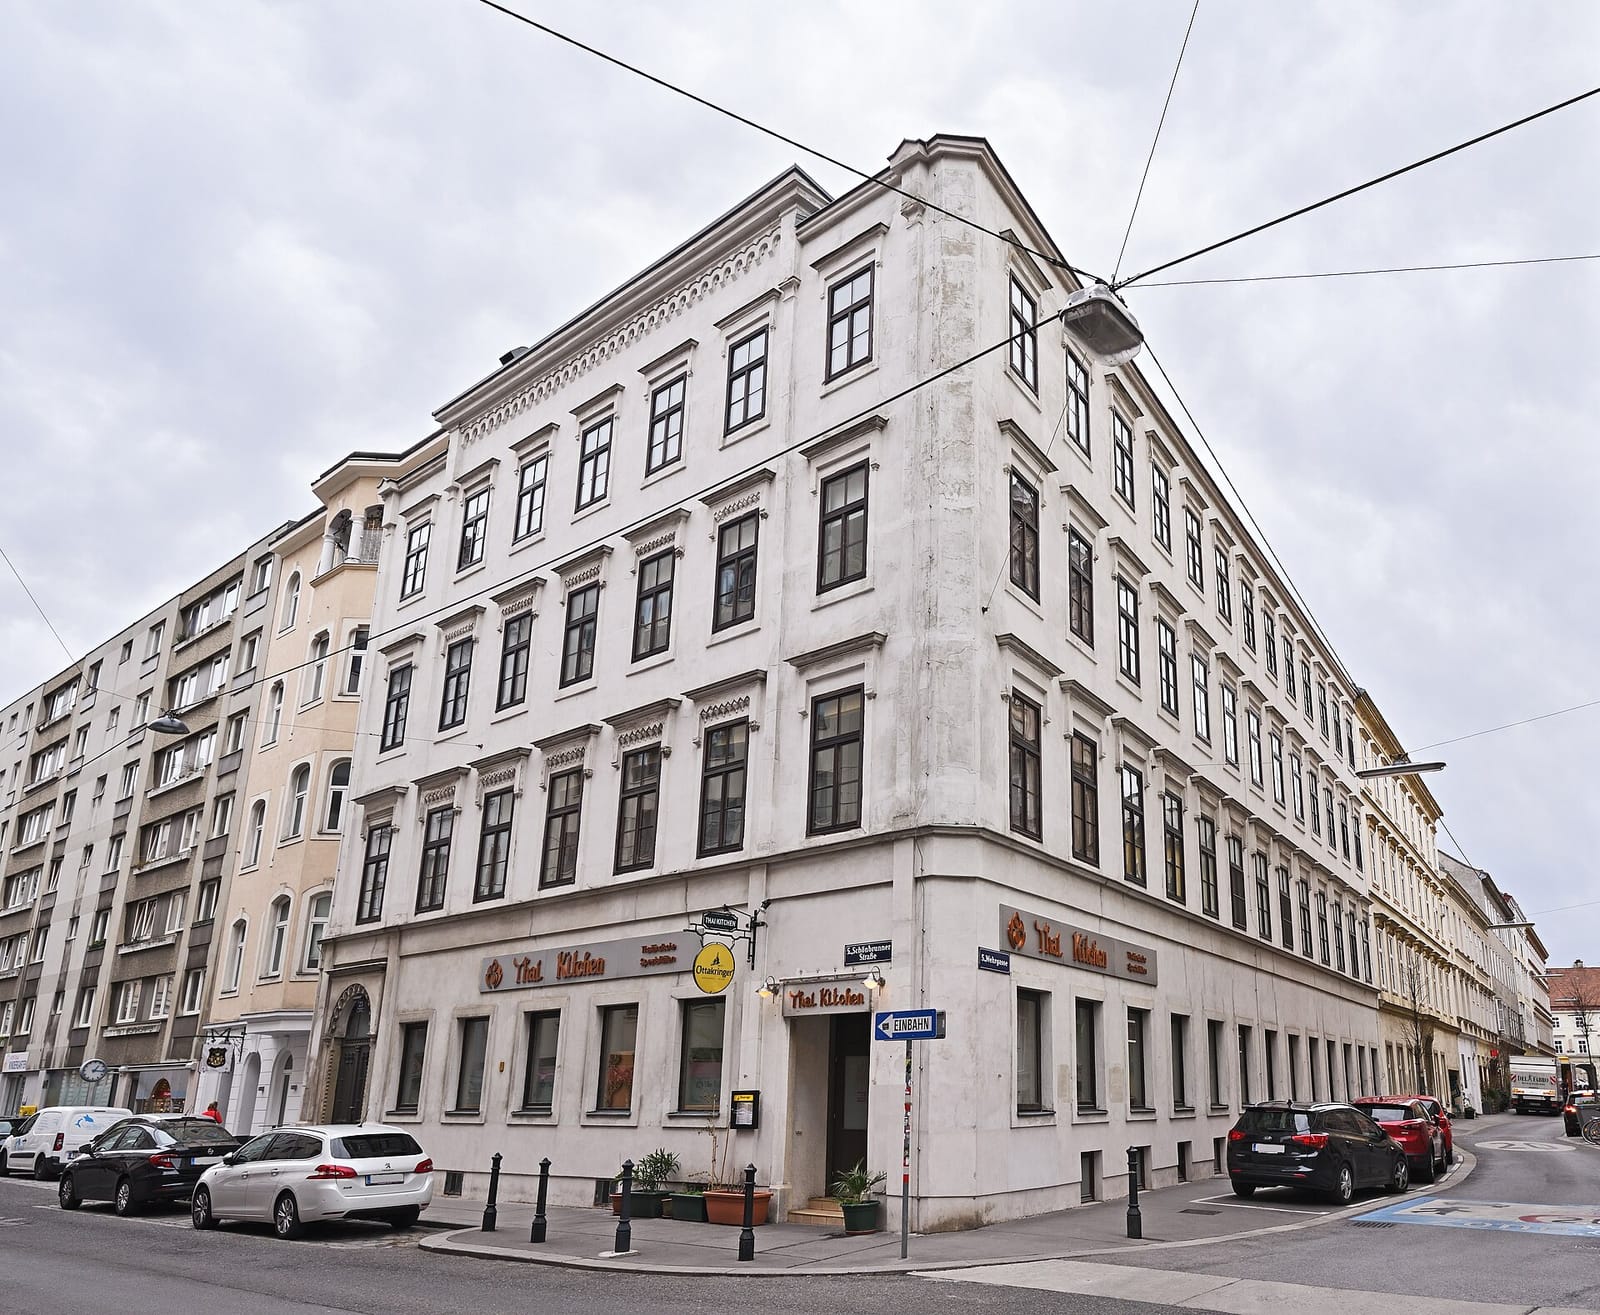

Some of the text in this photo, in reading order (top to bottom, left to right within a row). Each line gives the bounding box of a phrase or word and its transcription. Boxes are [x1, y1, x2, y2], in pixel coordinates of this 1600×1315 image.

[705, 916, 736, 927] THAI KITCHEN
[1034, 919, 1107, 968] Thai Kitchen
[859, 952, 878, 961] Straße
[513, 950, 605, 984] Thai Kitchen
[696, 965, 735, 978] Ottakringer
[789, 987, 865, 1008] Thai Kitchen
[893, 1017, 929, 1032] EINBAHN
